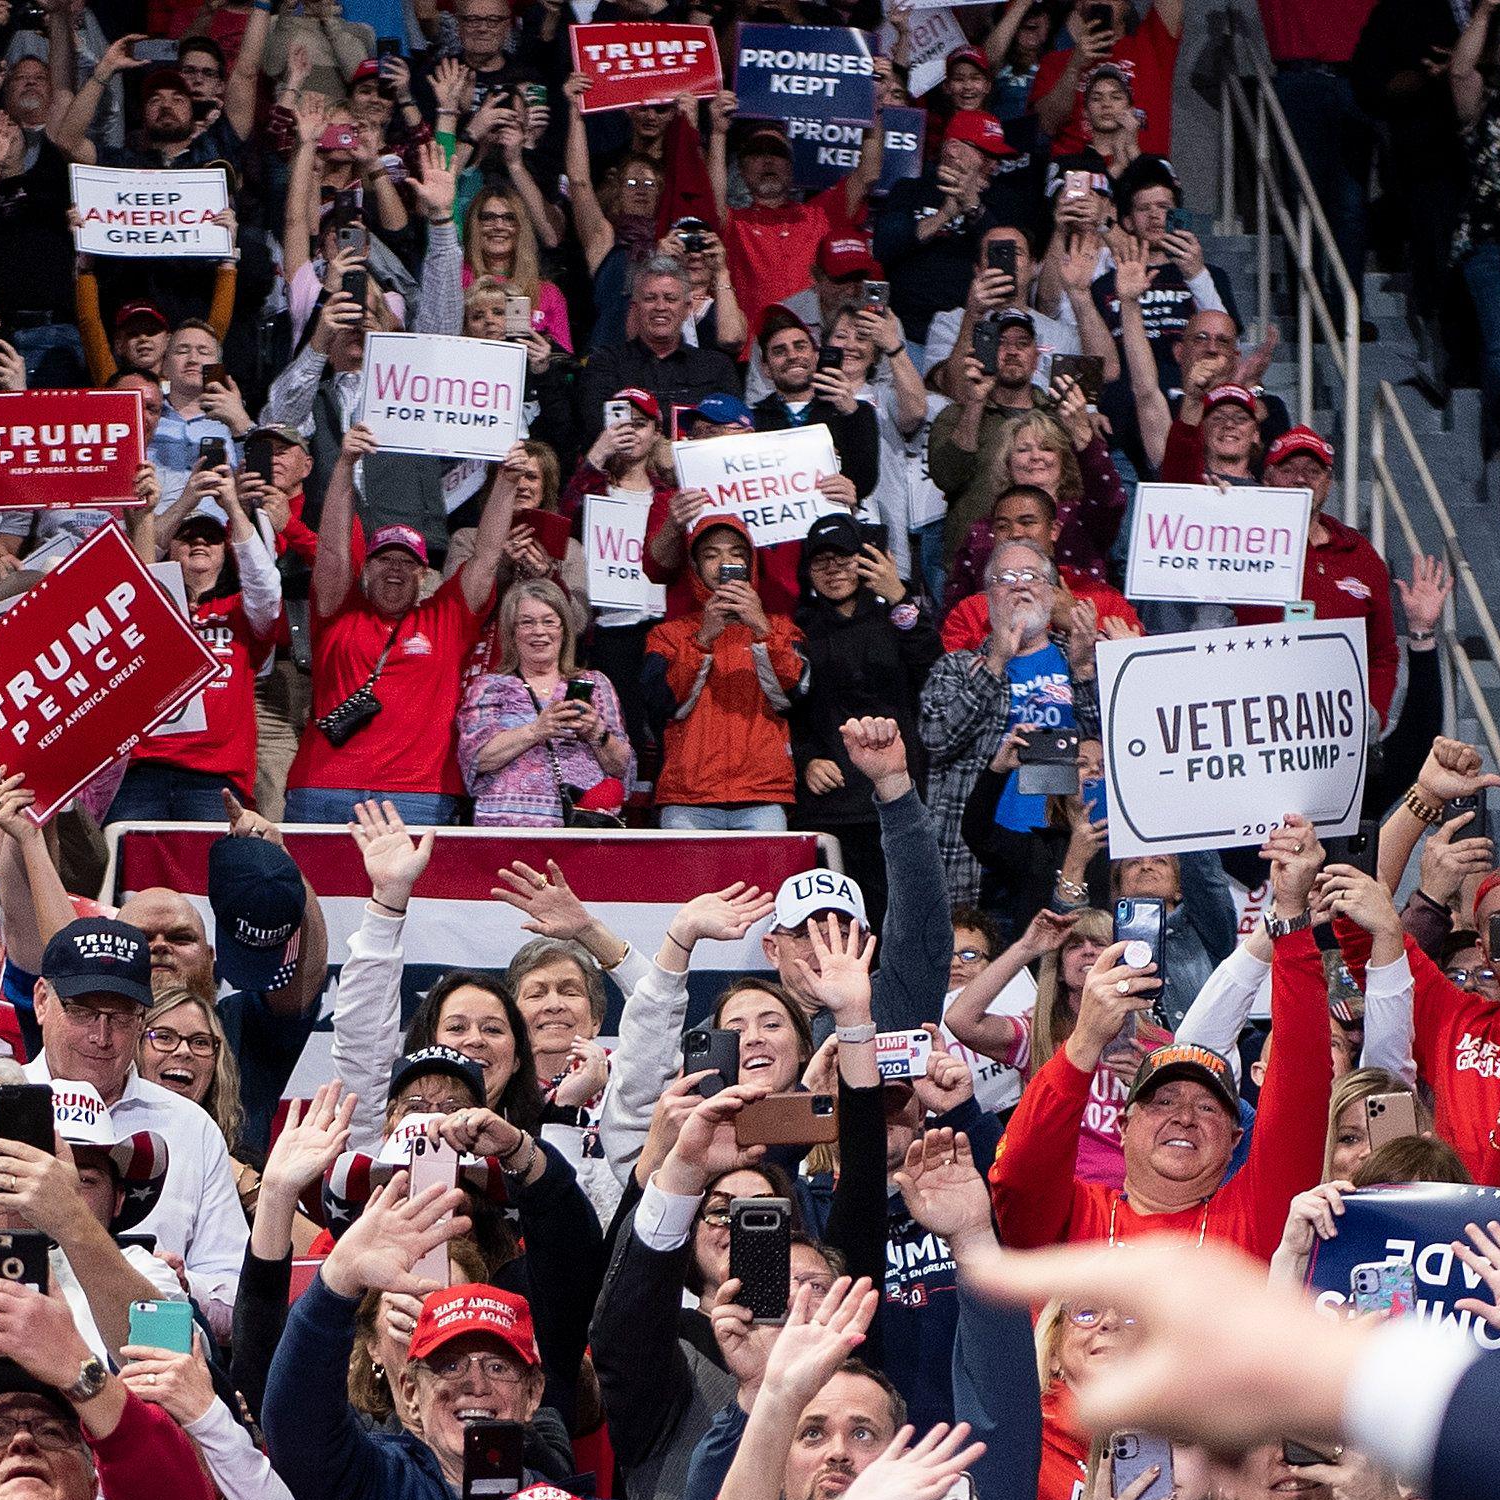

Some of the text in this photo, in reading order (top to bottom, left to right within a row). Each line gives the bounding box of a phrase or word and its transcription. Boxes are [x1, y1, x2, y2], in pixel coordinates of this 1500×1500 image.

[581, 41, 706, 64] TRUMP
[739, 49, 875, 74] PROMISES
[596, 55, 697, 73] PENCE
[770, 73, 836, 97] KEPT
[789, 119, 916, 150] PROMES
[817, 144, 861, 166] KEP
[116, 191, 182, 205] KEEP
[83, 208, 217, 226] AMERICA
[106, 227, 201, 244] GREAT!
[374, 362, 511, 411] Women
[386, 406, 499, 428] FOR TRUMP
[0, 446, 119, 463] PENCE
[722, 449, 788, 473] KEEP
[739, 495, 819, 525] REAT!
[1146, 512, 1292, 554] Women
[608, 566, 639, 580] FOR
[1158, 554, 1275, 572] FOR TRUMP
[10, 623, 147, 746] PENCE
[37, 723, 65, 750] KEEP
[64, 687, 110, 729] AMERICA
[107, 656, 147, 693] GREAT!
[1156, 689, 1354, 752] VETERANS
[117, 735, 140, 755] 2020
[1187, 748, 1341, 782] FOR TRUMP
[1243, 821, 1293, 836] 202
[792, 874, 855, 905] USA
[235, 917, 292, 940] Trump
[73, 933, 140, 952] TRUMP
[79, 945, 135, 960] PENCE
[1150, 1046, 1227, 1073] TRUMP
[52, 1093, 107, 1115] RUMP
[57, 1106, 96, 1126] 020
[432, 1302, 465, 1319] MAKE
[437, 1311, 513, 1330] GREAT AGAIN
